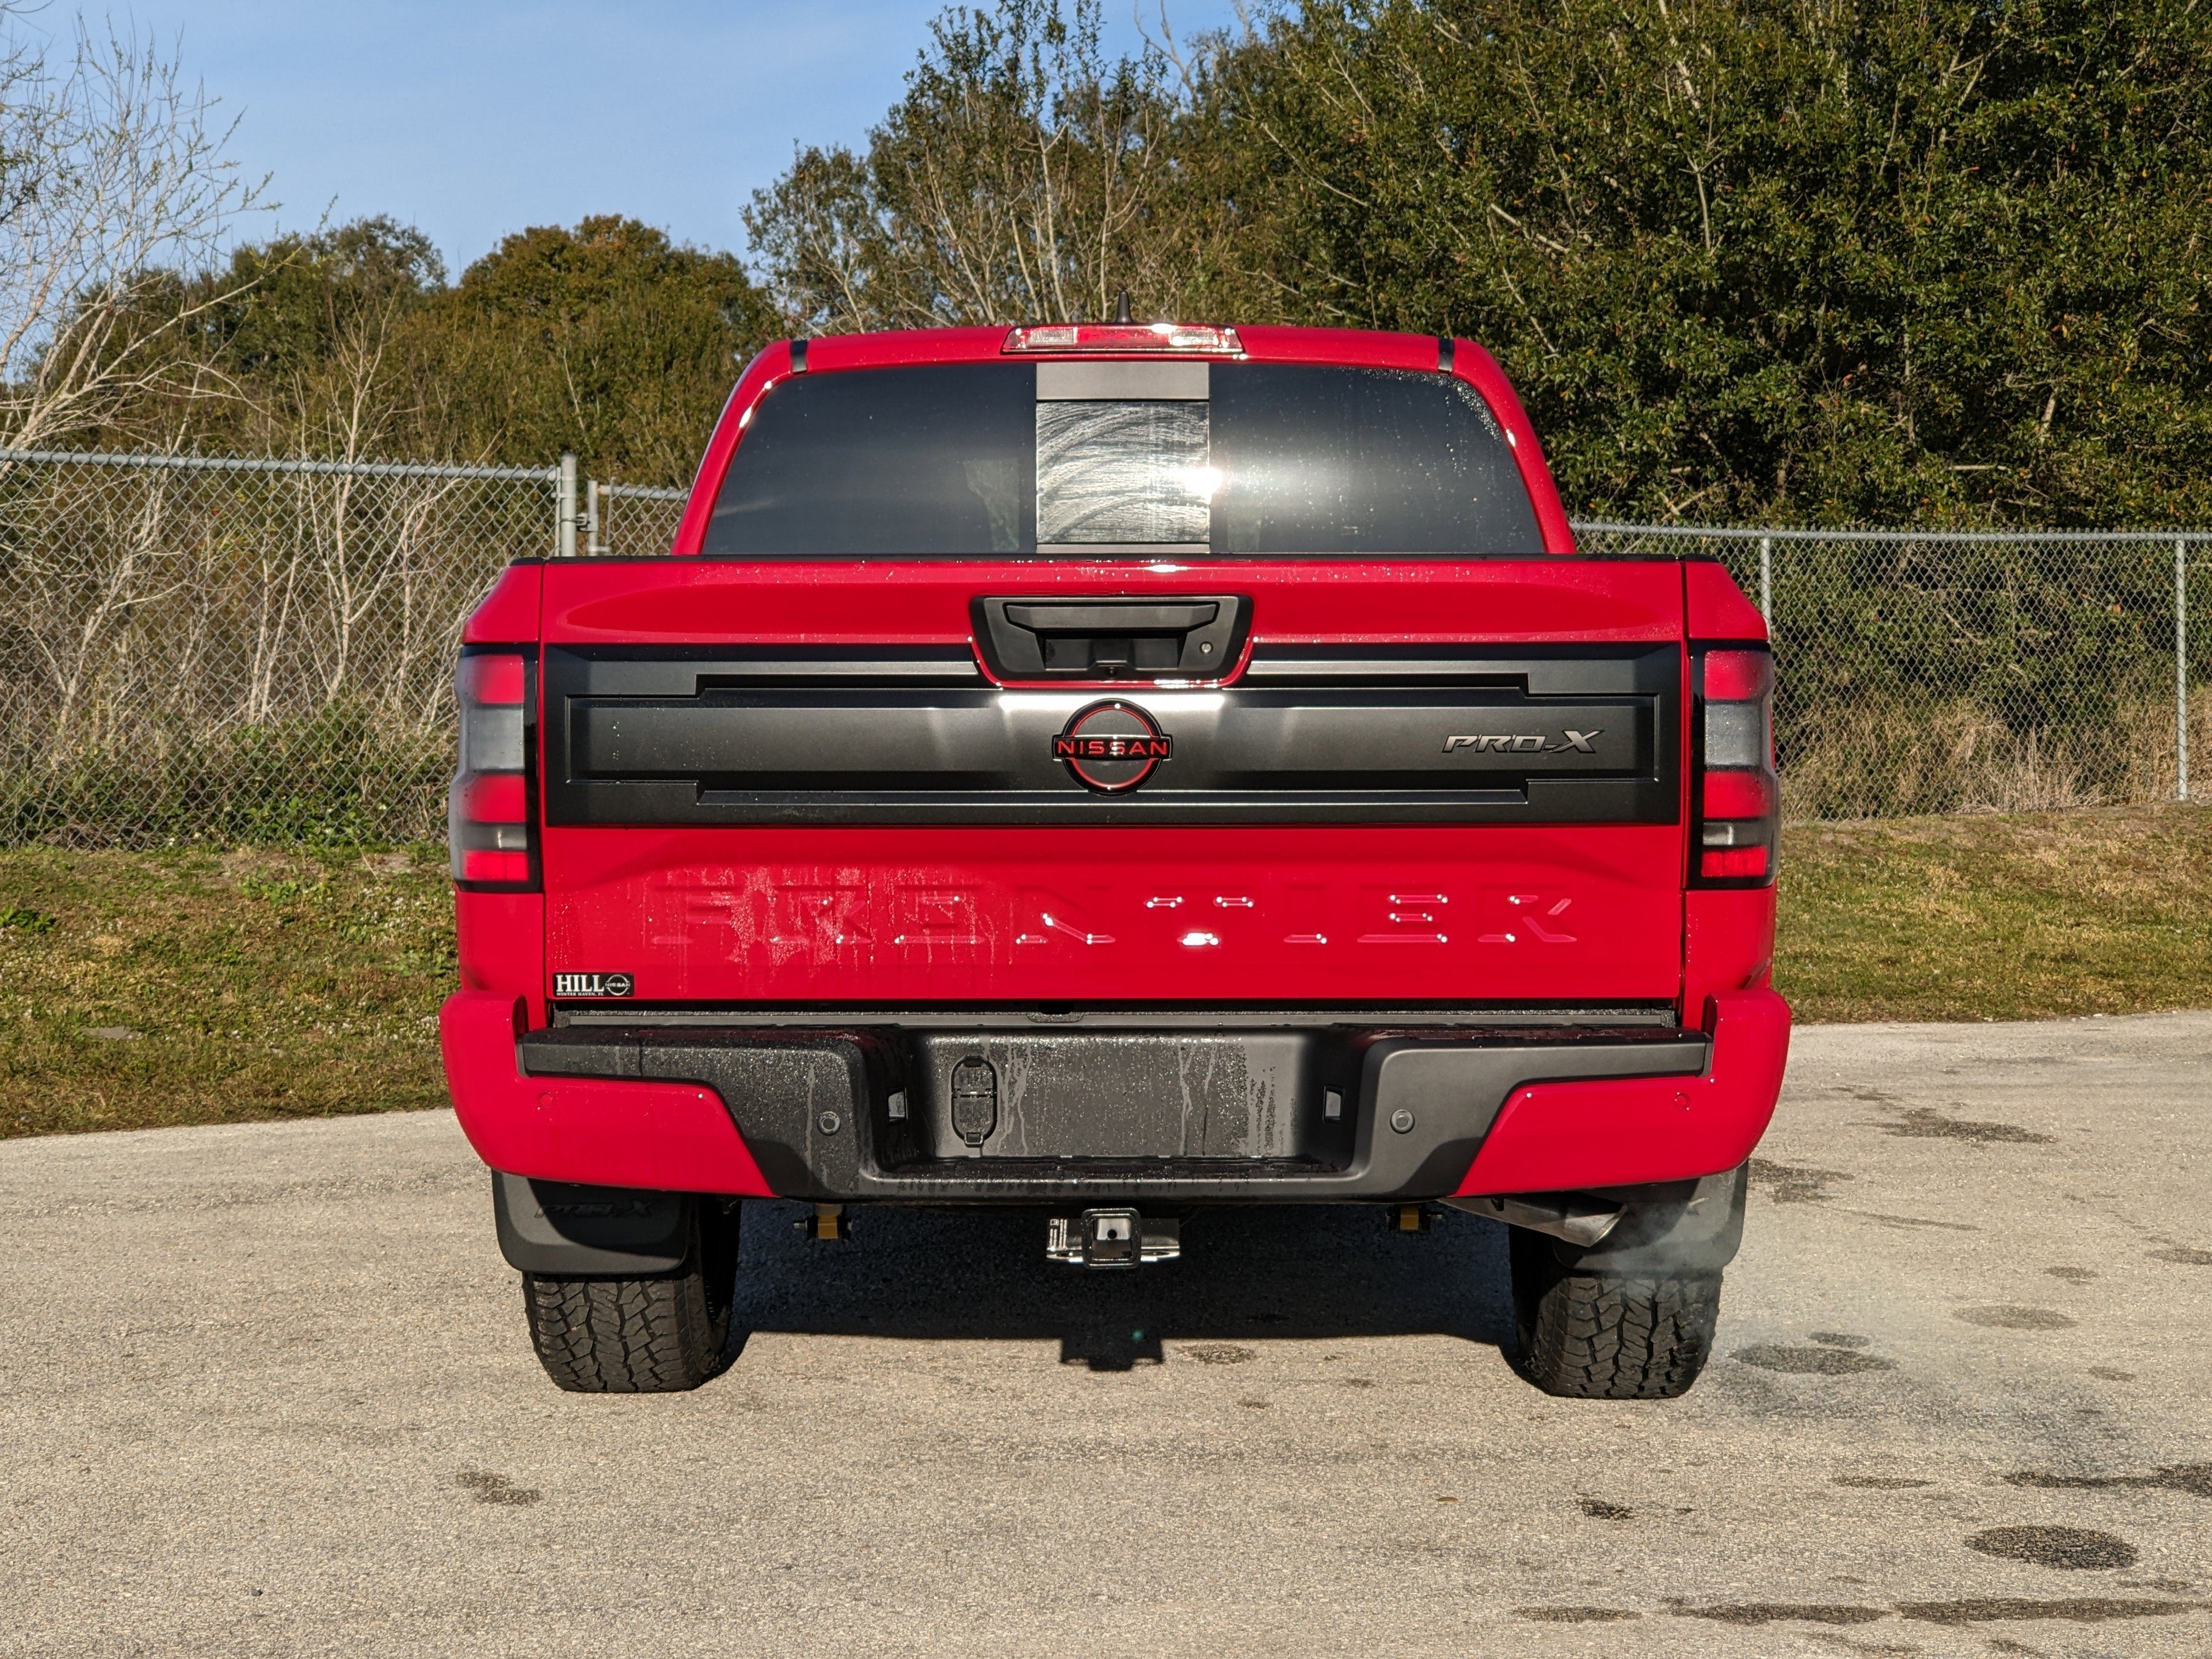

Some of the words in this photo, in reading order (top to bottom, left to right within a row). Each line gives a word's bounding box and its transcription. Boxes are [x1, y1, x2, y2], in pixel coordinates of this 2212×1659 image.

[1057, 741, 1167, 755] NISSAN
[1441, 730, 1604, 754] PRO-X
[651, 884, 1578, 944] FRONTIER
[556, 974, 604, 992] HILL
